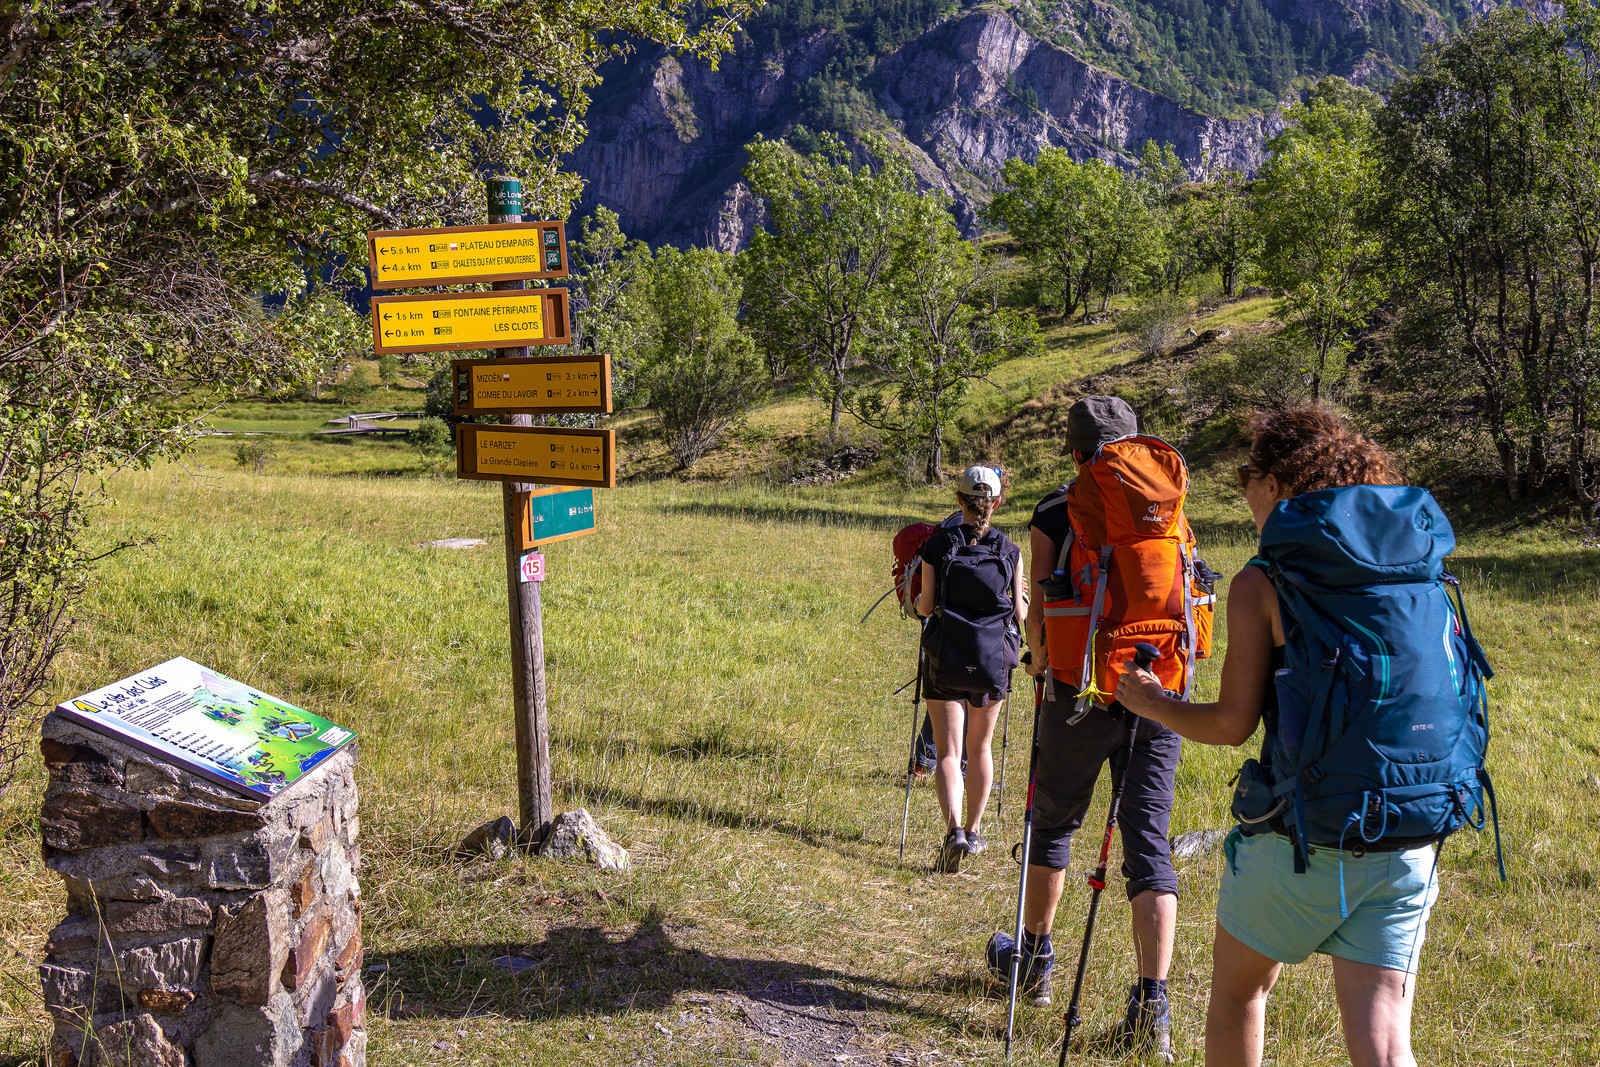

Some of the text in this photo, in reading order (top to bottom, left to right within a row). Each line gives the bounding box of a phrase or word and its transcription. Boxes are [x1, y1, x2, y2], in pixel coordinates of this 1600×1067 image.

[390, 246, 403, 254] 5.5
[460, 240, 494, 250] PLATEAU
[496, 238, 534, 248] D'EMPARIS
[453, 258, 476, 268] CHALETS
[477, 258, 485, 266] DU
[486, 258, 496, 266] FAY
[505, 255, 536, 264] MOUTERRES
[454, 308, 490, 317] FONTAINE
[493, 305, 537, 315] PÉTRIFIANTE
[494, 323, 509, 332] LES
[512, 322, 538, 331] CLOTS
[478, 390, 500, 399] COMBE
[514, 390, 538, 398] LAVOIR
[490, 441, 516, 450] PARIZET
[489, 457, 512, 465] Grande
[513, 458, 538, 468] Clapière
[570, 462, 579, 470] 0.6
[526, 561, 539, 574] 15
[134, 676, 167, 690] Clots
